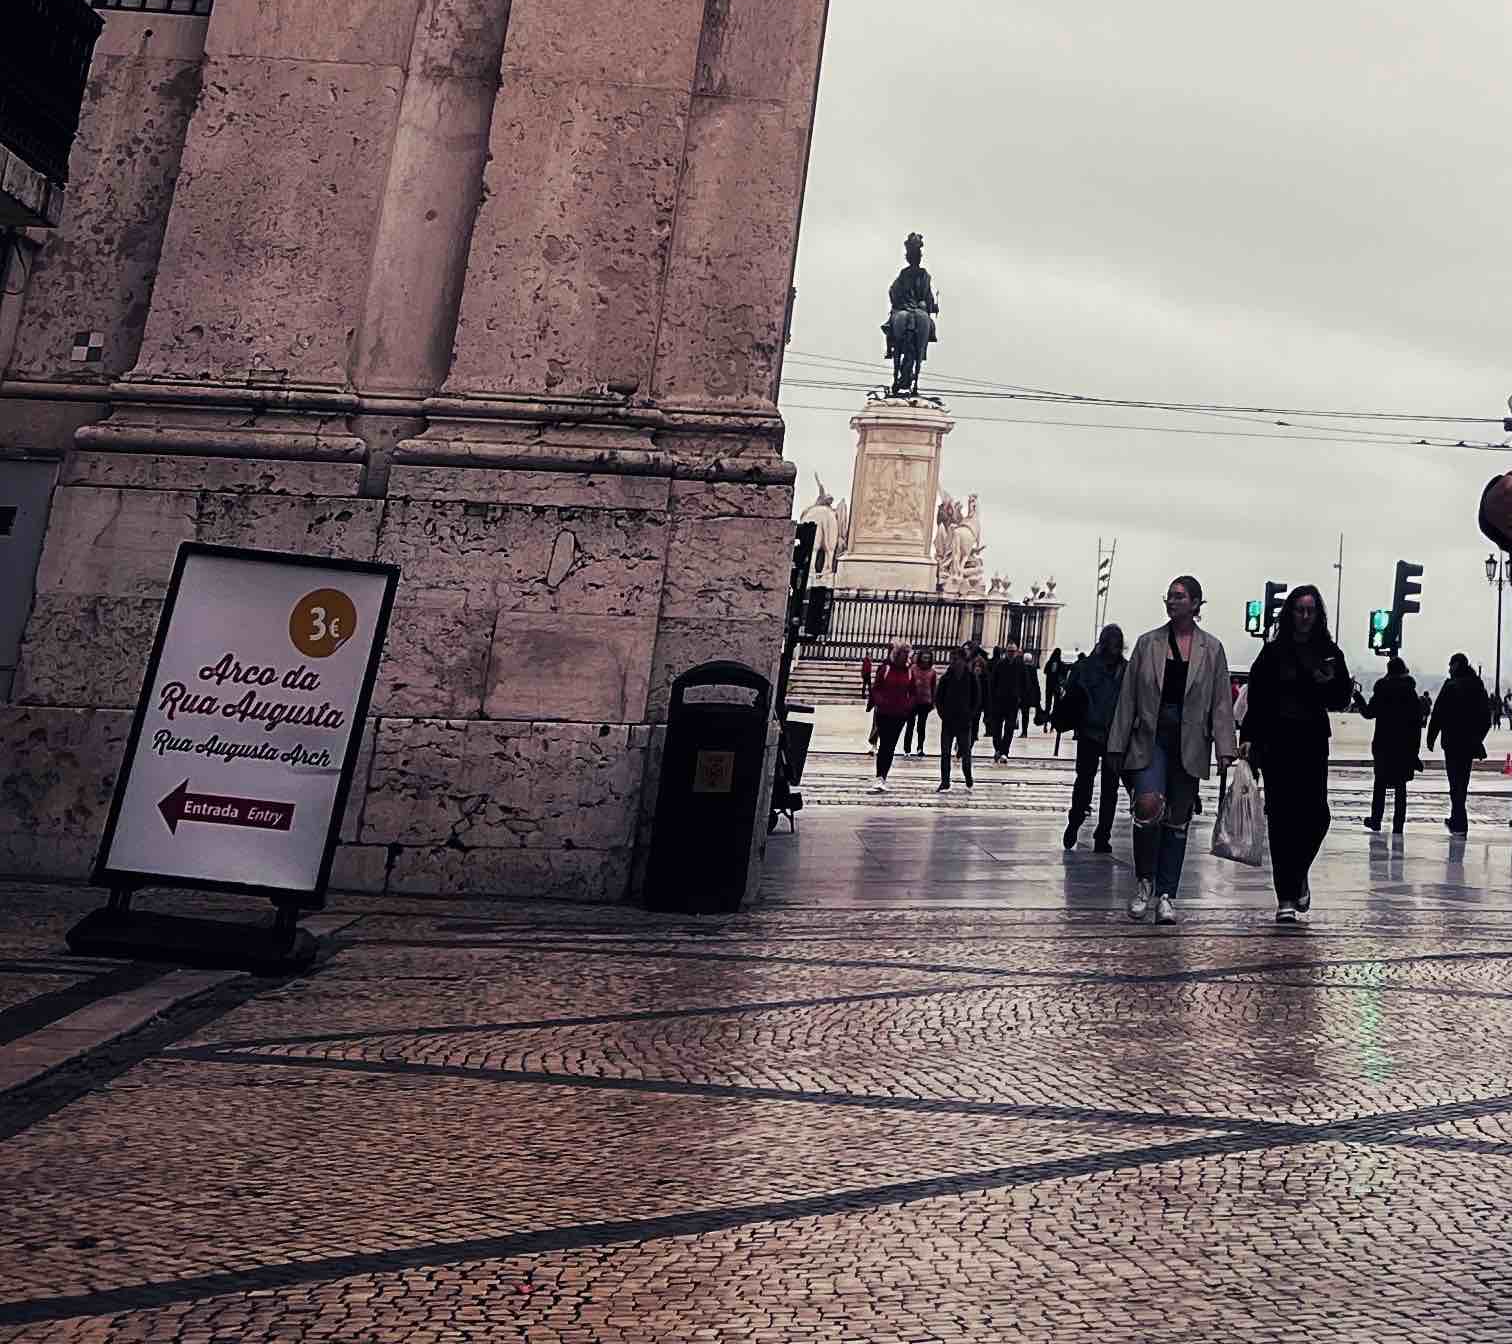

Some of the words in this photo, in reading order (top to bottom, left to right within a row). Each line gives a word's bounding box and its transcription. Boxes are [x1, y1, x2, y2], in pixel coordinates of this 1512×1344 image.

[308, 606, 340, 641] 3€
[199, 653, 279, 686] Arco
[282, 665, 321, 692] da
[159, 681, 218, 721] Rua
[222, 690, 345, 732] Augusta
[153, 728, 193, 756] Rua
[195, 735, 279, 763] Augusta
[280, 744, 332, 768] Arch
[183, 799, 240, 820] Entrada
[247, 807, 284, 827] Entry
